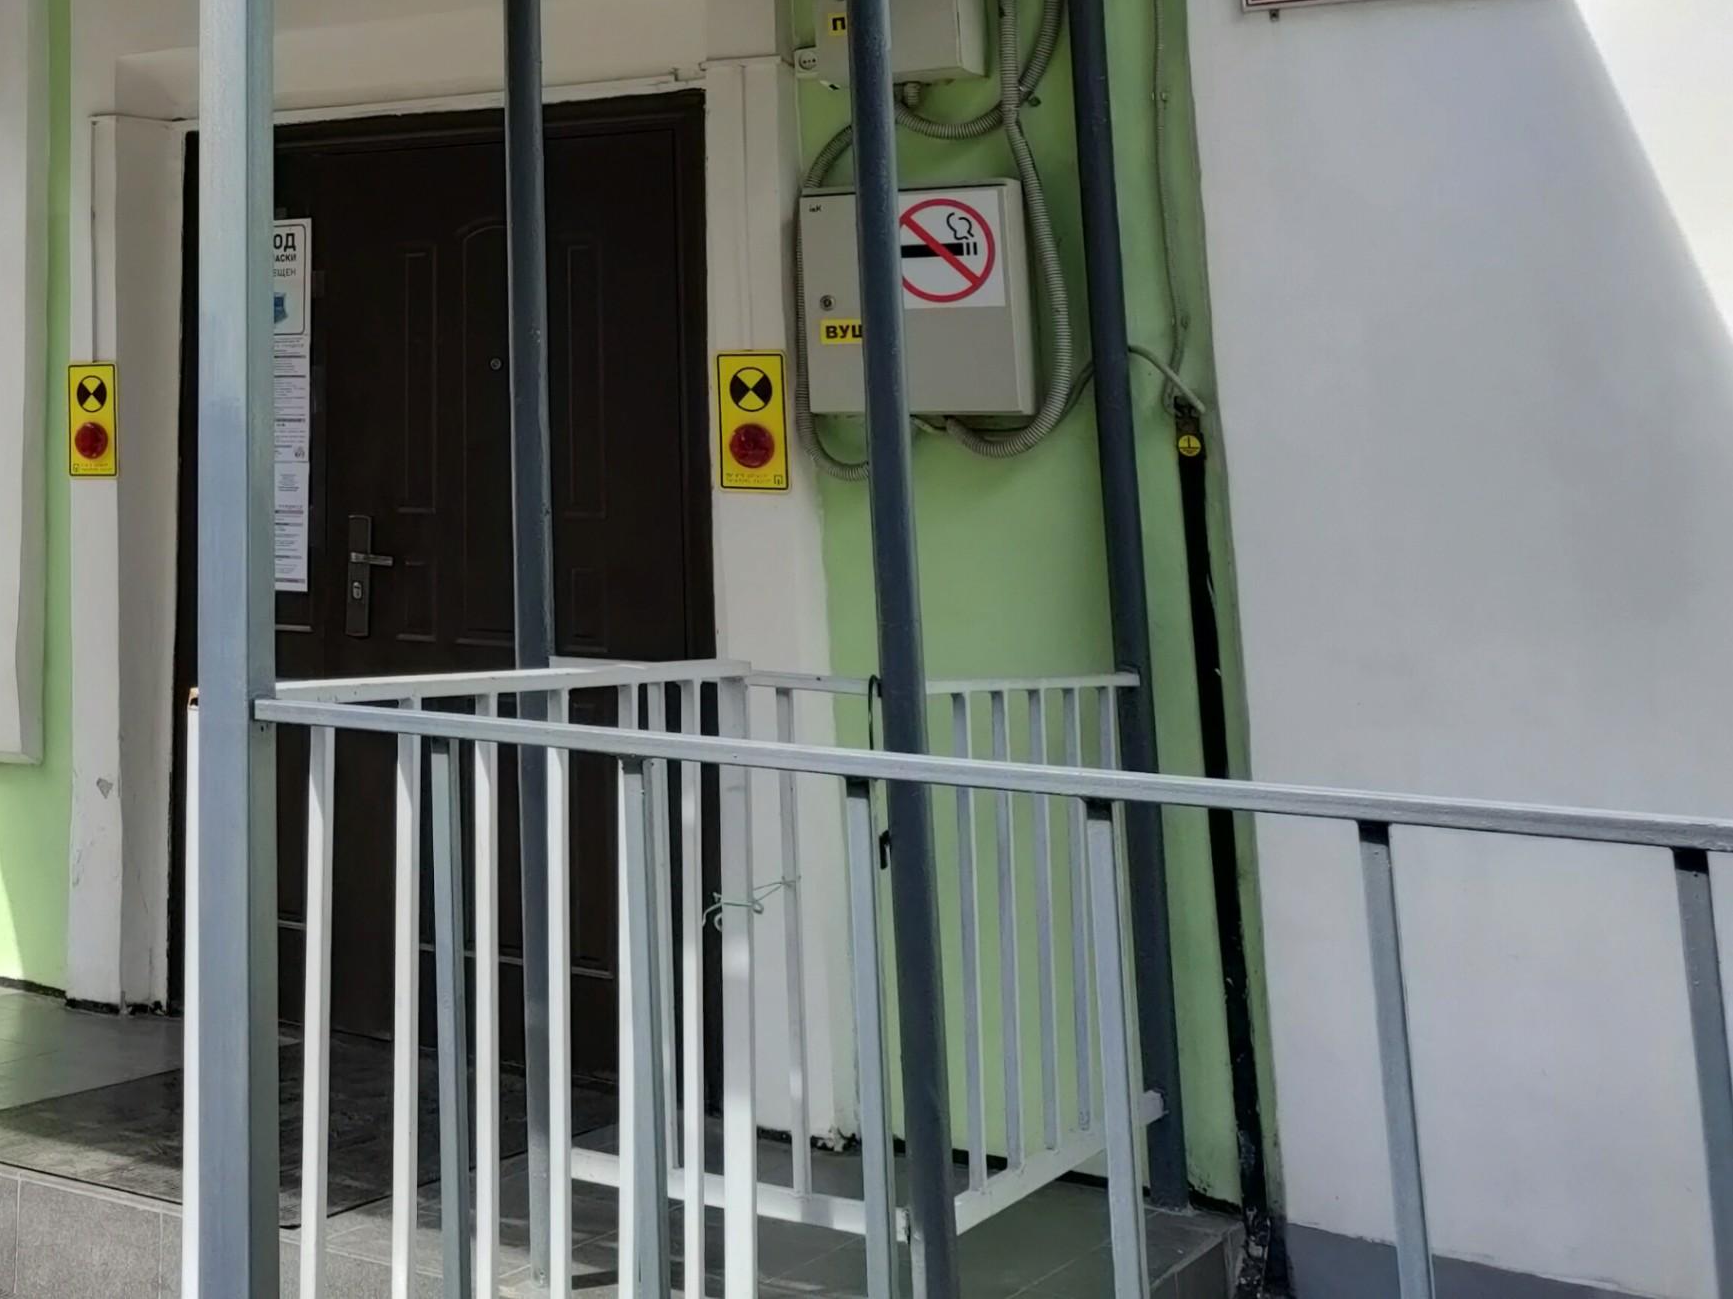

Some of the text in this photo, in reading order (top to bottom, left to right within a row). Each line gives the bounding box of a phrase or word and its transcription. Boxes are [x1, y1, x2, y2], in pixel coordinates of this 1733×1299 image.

[273, 233, 296, 252] ОД
[274, 253, 297, 262] АСКИ
[274, 268, 297, 278] ЕЩЕН
